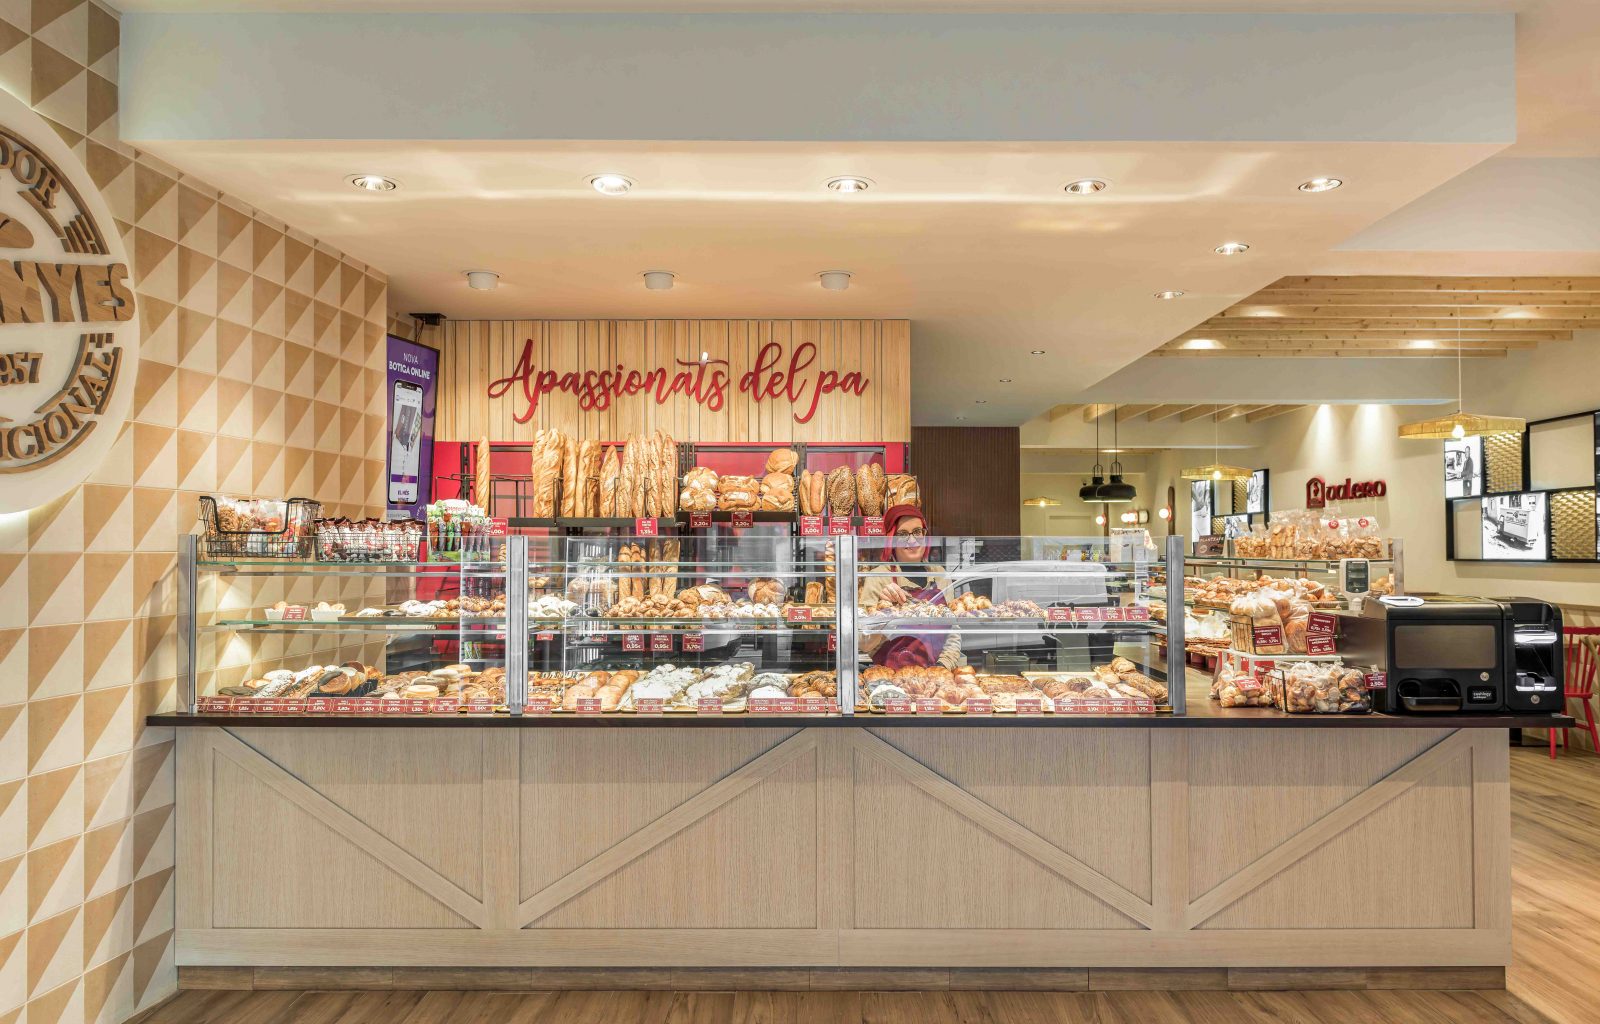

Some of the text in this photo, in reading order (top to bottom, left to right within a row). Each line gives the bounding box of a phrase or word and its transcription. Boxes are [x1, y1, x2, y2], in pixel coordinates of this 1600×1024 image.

[388, 360, 431, 380] BOTIGA ONLINE
[487, 338, 869, 424] Apassionats del pa
